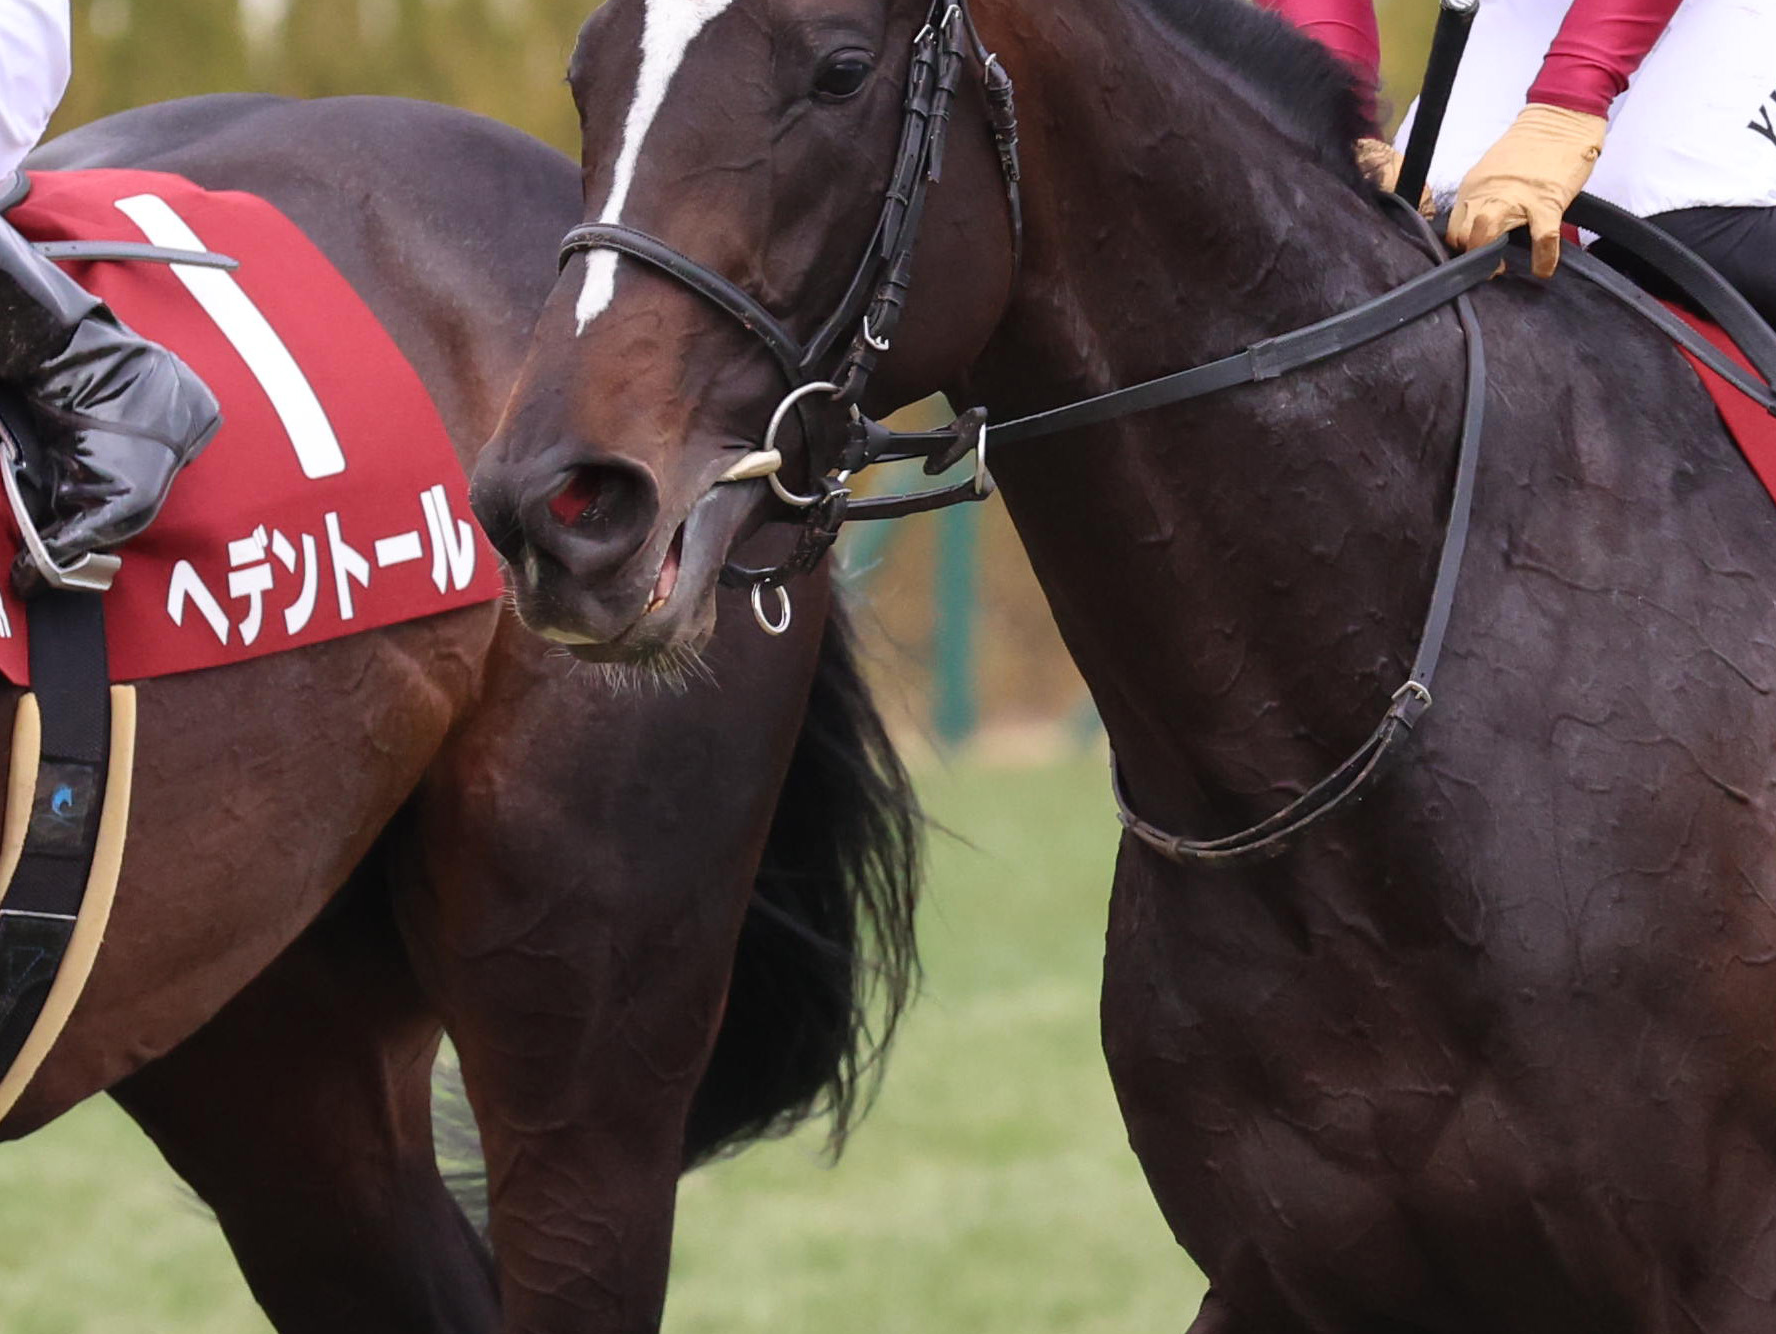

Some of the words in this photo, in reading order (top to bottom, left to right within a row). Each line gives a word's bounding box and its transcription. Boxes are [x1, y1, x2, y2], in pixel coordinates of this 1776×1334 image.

[113, 193, 346, 480] 1
[167, 484, 476, 646] ヘデントール
